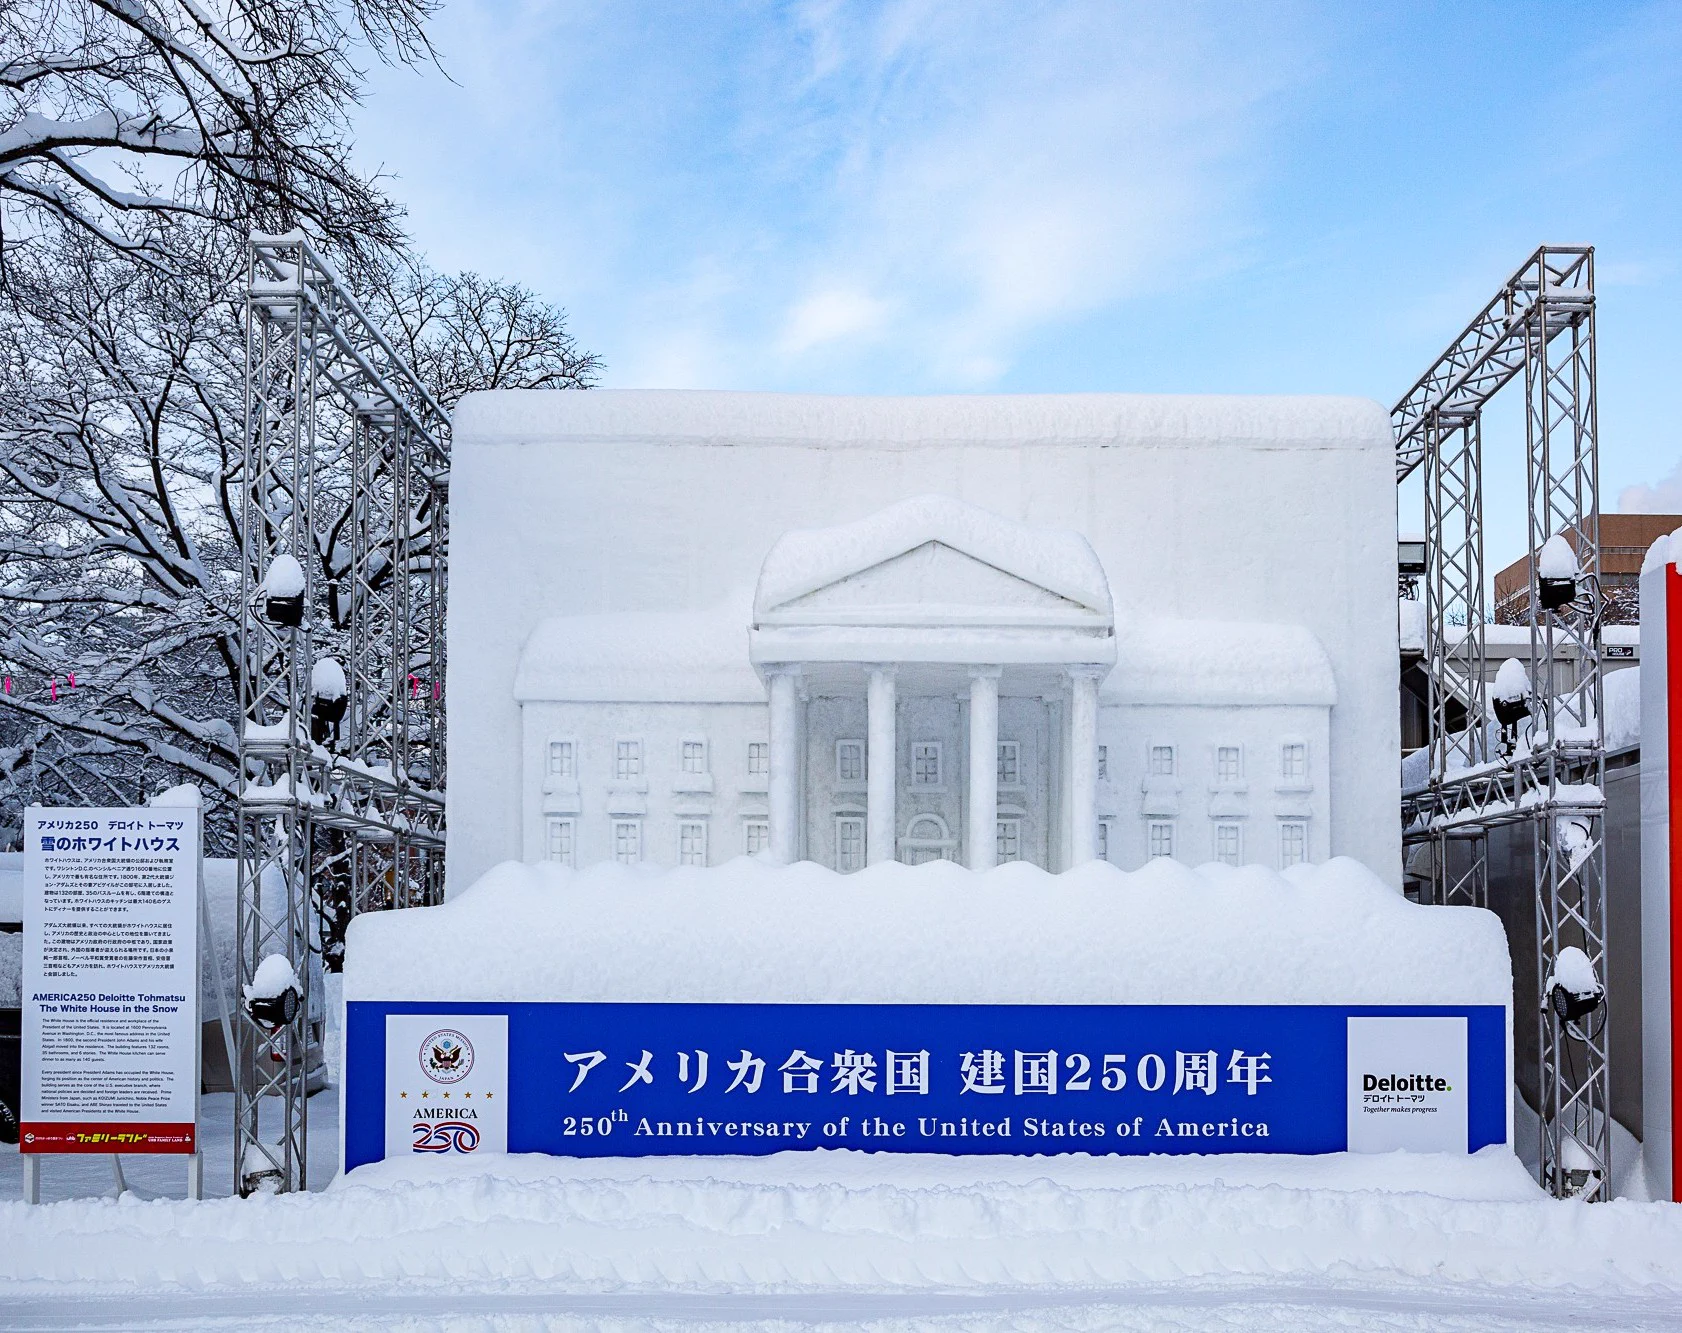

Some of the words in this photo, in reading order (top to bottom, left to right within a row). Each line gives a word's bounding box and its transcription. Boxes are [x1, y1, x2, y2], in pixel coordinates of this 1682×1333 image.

[38, 821, 98, 830] アメリカ250
[108, 821, 144, 830] デロイト
[148, 821, 184, 830] トーマツ
[41, 836, 180, 851] 雪のホワイトハウス
[32, 993, 96, 1002] AMERICA250
[99, 993, 135, 1002] Deloitte
[138, 994, 186, 1002] Tohmatsu
[39, 1004, 58, 1013] The
[60, 1004, 88, 1013] White
[90, 1004, 120, 1013] House
[123, 1004, 132, 1013] in
[134, 1004, 150, 1013] the
[152, 1004, 178, 1013] Snow
[564, 1049, 930, 1096] アメリカ合衆国
[959, 1049, 1272, 1096] 建国250周年
[1363, 1094, 1394, 1102] デロイト
[413, 1108, 478, 1118] AMERICA
[1363, 1106, 1390, 1114] Together
[563, 1109, 628, 1136] 250th
[634, 1117, 811, 1139] Anniversary
[823, 1117, 850, 1136] of
[861, 1117, 905, 1136] the
[918, 1118, 1011, 1137] United
[1024, 1118, 1105, 1137] States
[1116, 1118, 1142, 1137] of
[1154, 1118, 1270, 1137] America
[413, 1122, 480, 1153] 250
